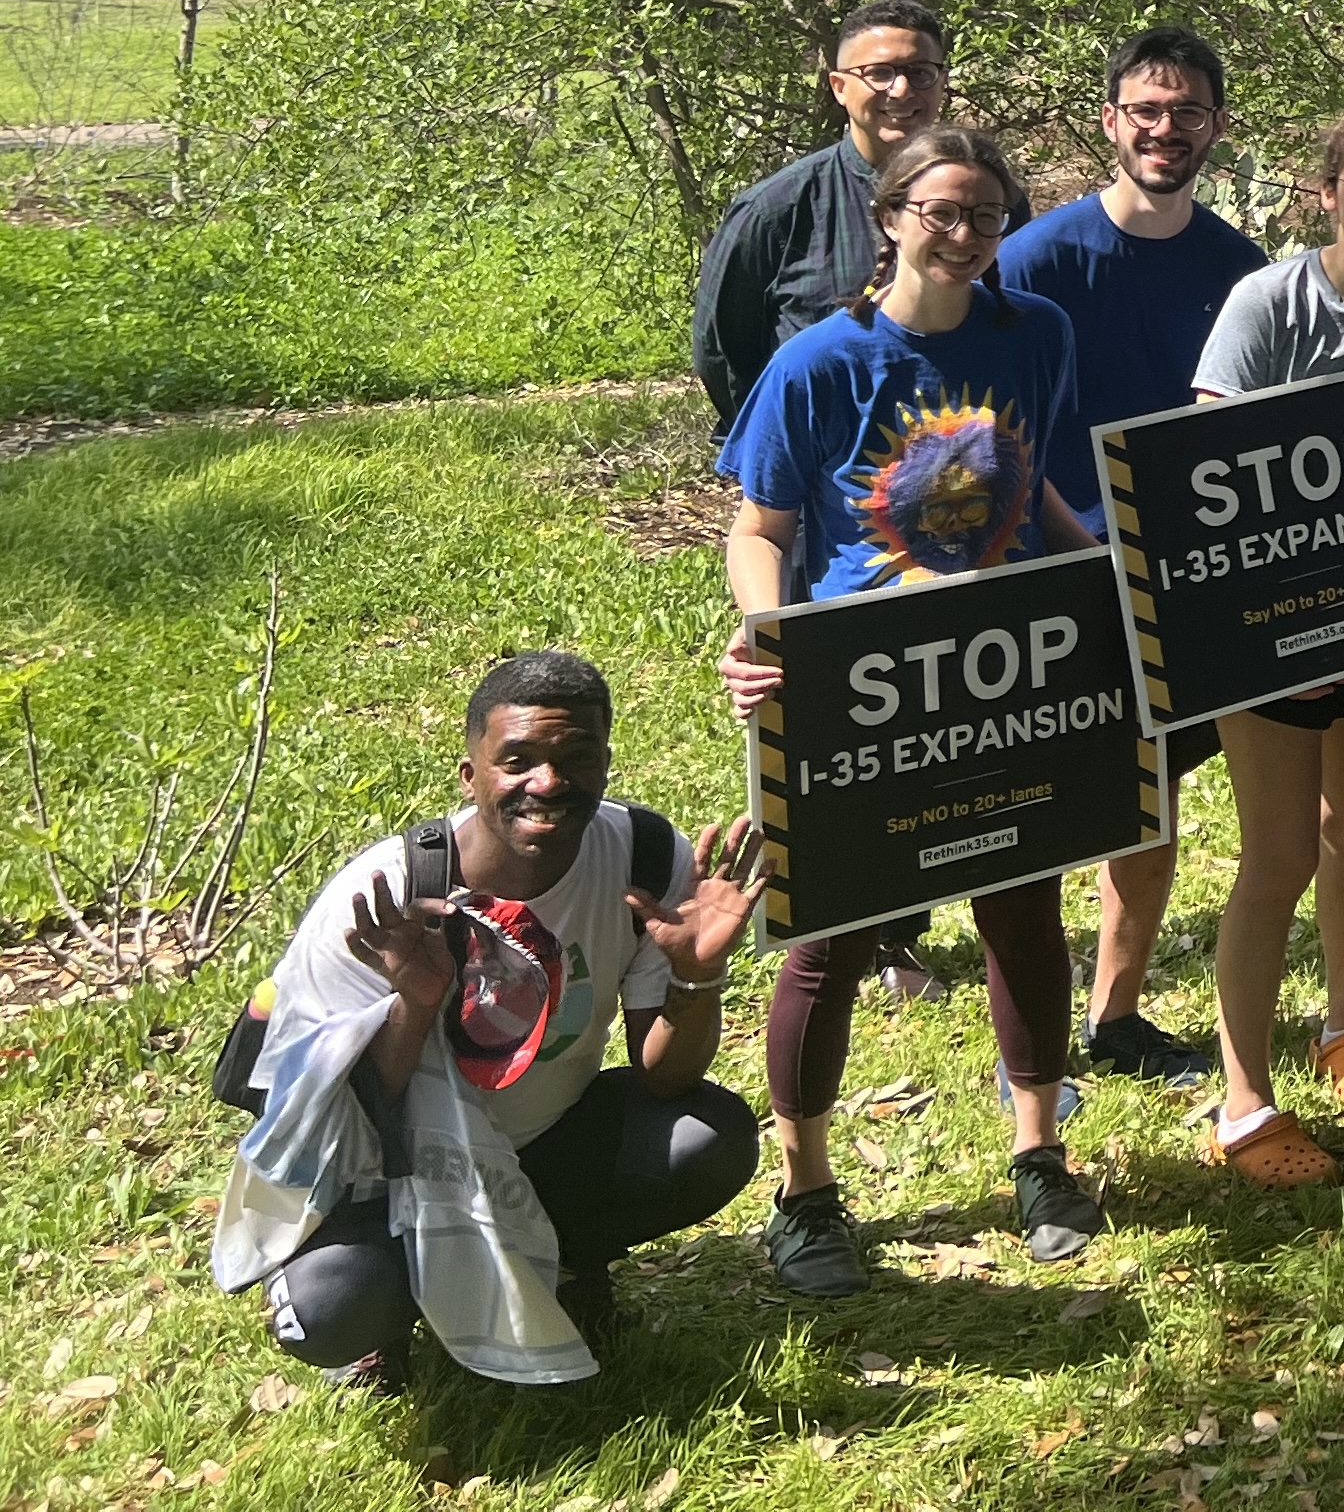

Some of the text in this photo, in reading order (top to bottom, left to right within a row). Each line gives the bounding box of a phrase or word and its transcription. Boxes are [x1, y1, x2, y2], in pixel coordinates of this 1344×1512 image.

[1159, 543, 1231, 591] I-35
[1242, 608, 1271, 626] Say
[1273, 599, 1296, 617] NO
[1299, 595, 1315, 611] to
[1317, 586, 1344, 606] 20+
[848, 615, 1079, 727] STOP
[800, 688, 1124, 795] I-35 EXPANSION
[886, 783, 1053, 834] Say NO to 20+ lanes
[923, 831, 1015, 865] Rethink35.org
